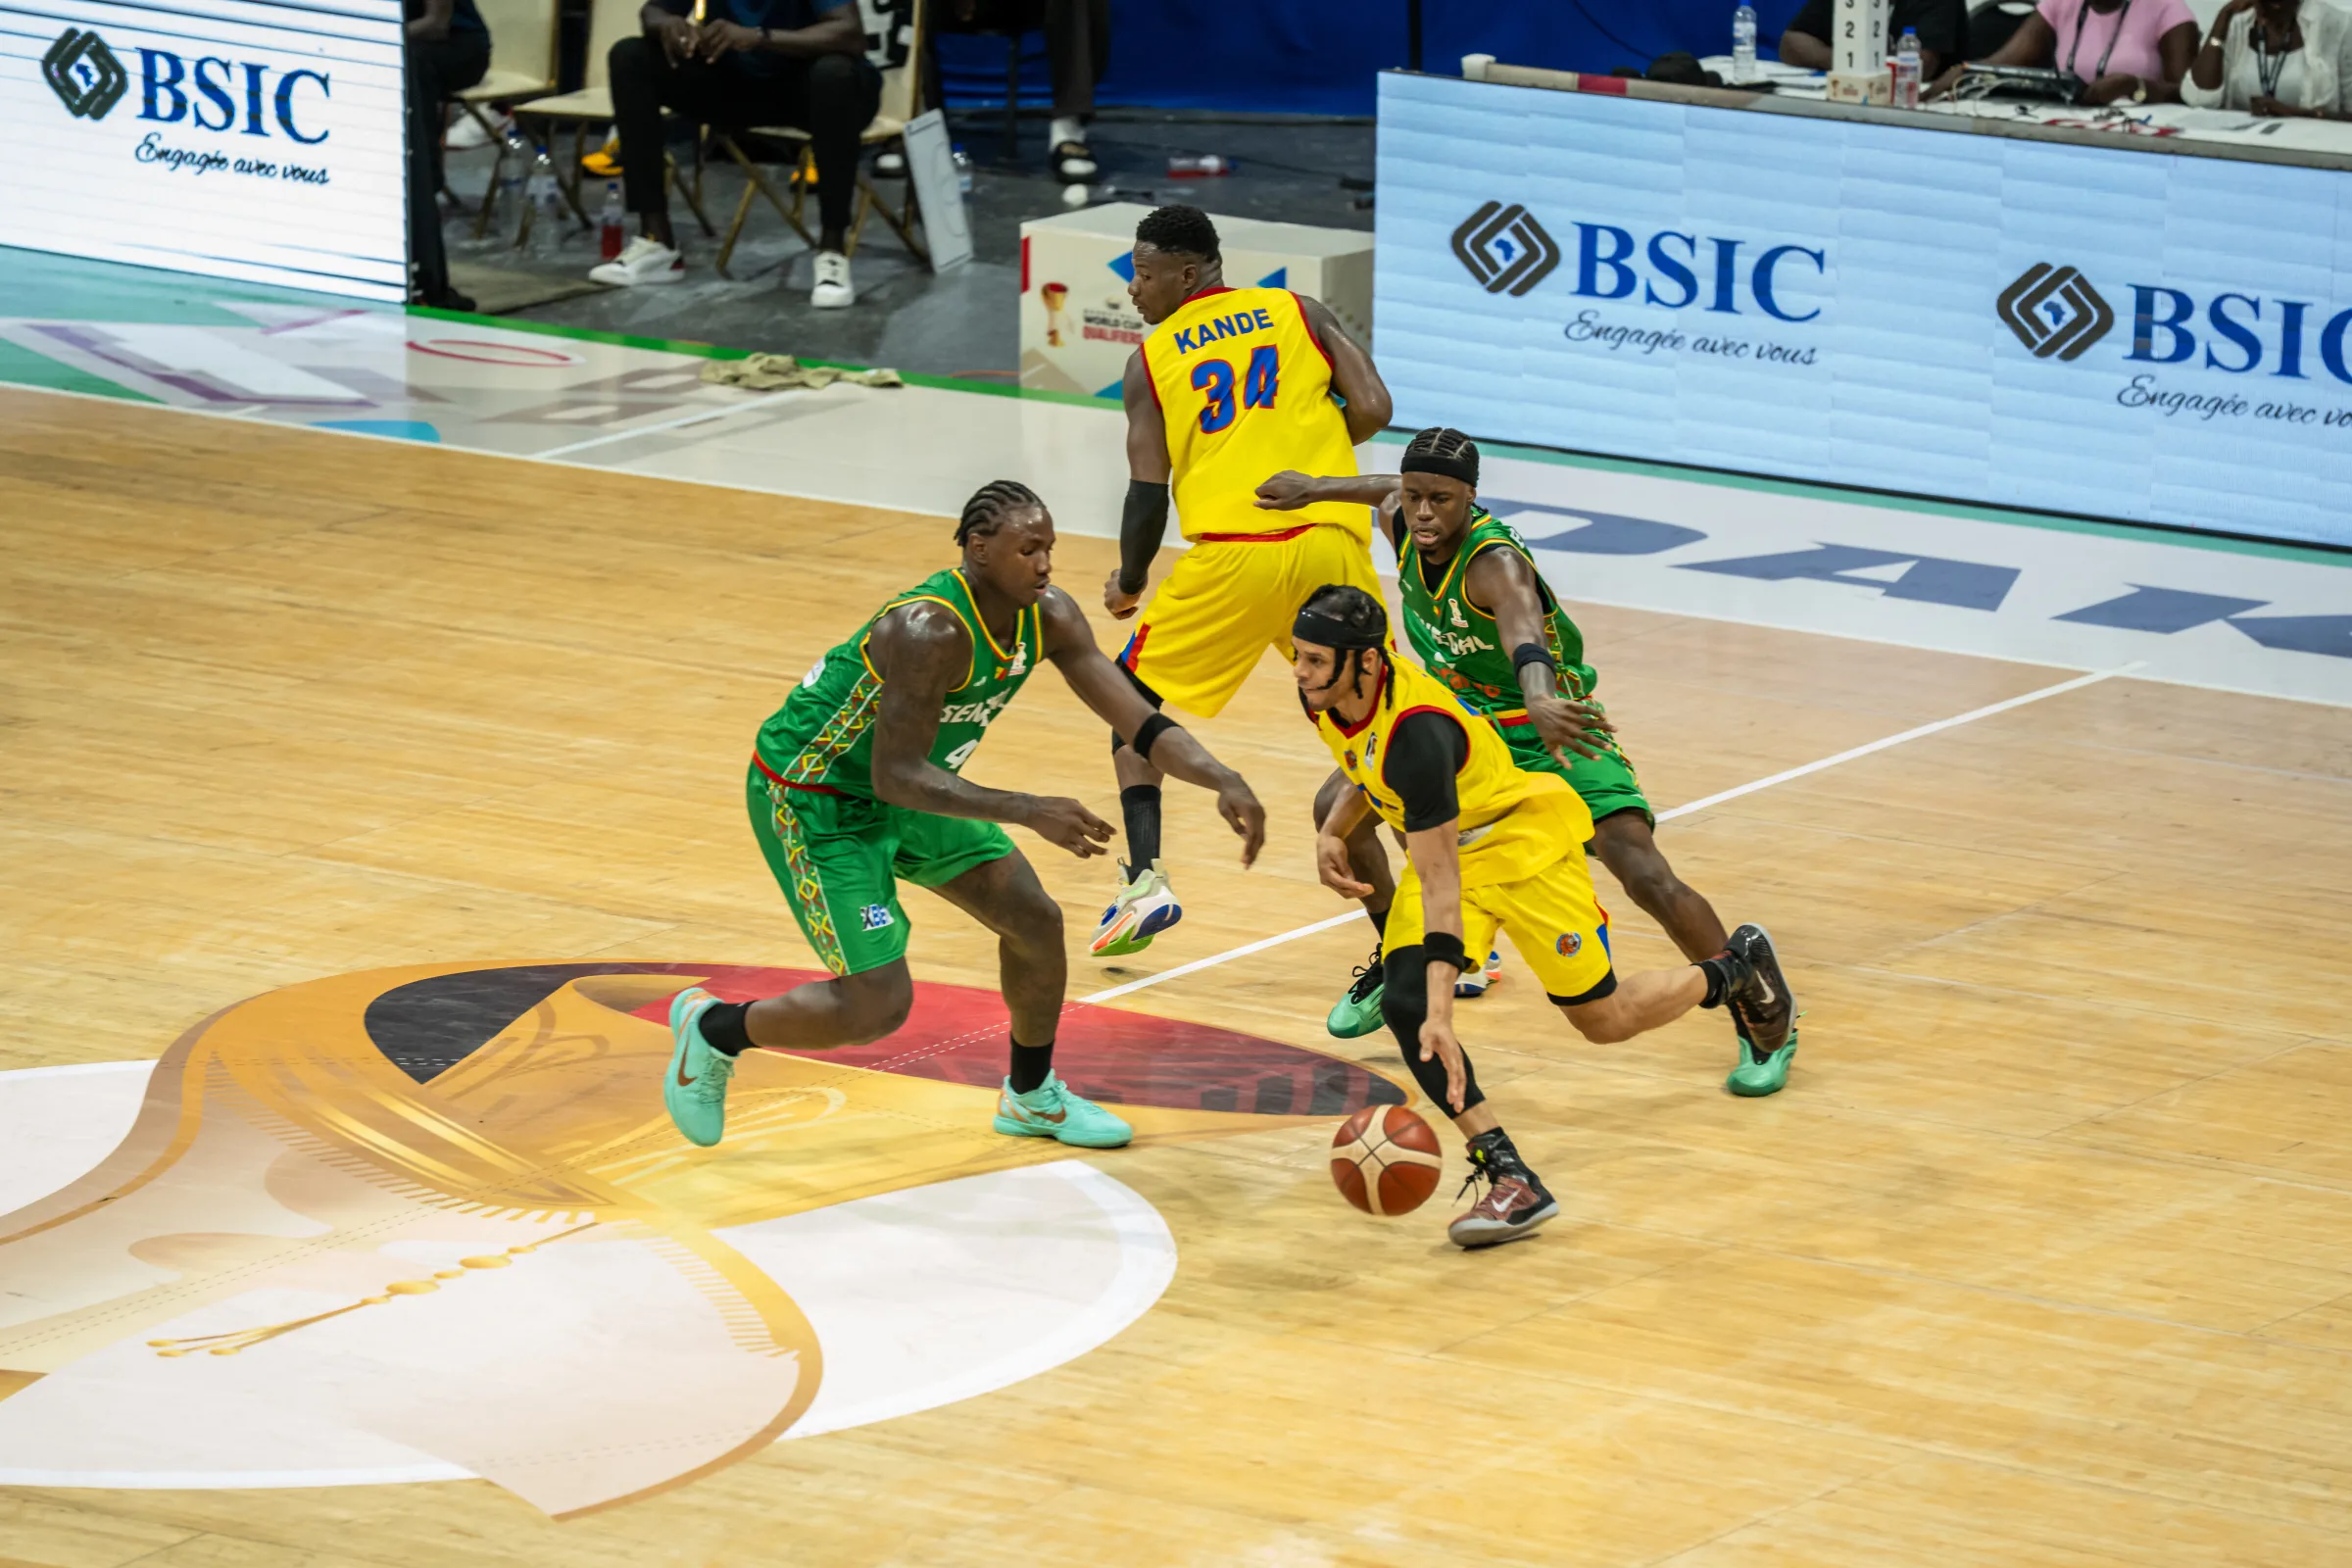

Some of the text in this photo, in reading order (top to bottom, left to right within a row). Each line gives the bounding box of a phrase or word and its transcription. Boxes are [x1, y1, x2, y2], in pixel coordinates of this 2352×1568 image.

[1845, 21, 1855, 38] 2
[1846, 51, 1853, 69] 1
[135, 47, 331, 145] BSIC
[135, 132, 330, 185] Engagée avec vous
[1569, 220, 1825, 322] BSIC
[1173, 308, 1274, 355] KANDE
[1564, 310, 1818, 366] Engagée avec vous
[1190, 343, 1279, 434] 34
[2116, 373, 2248, 420] Engagée
[2254, 402, 2318, 424] avec
